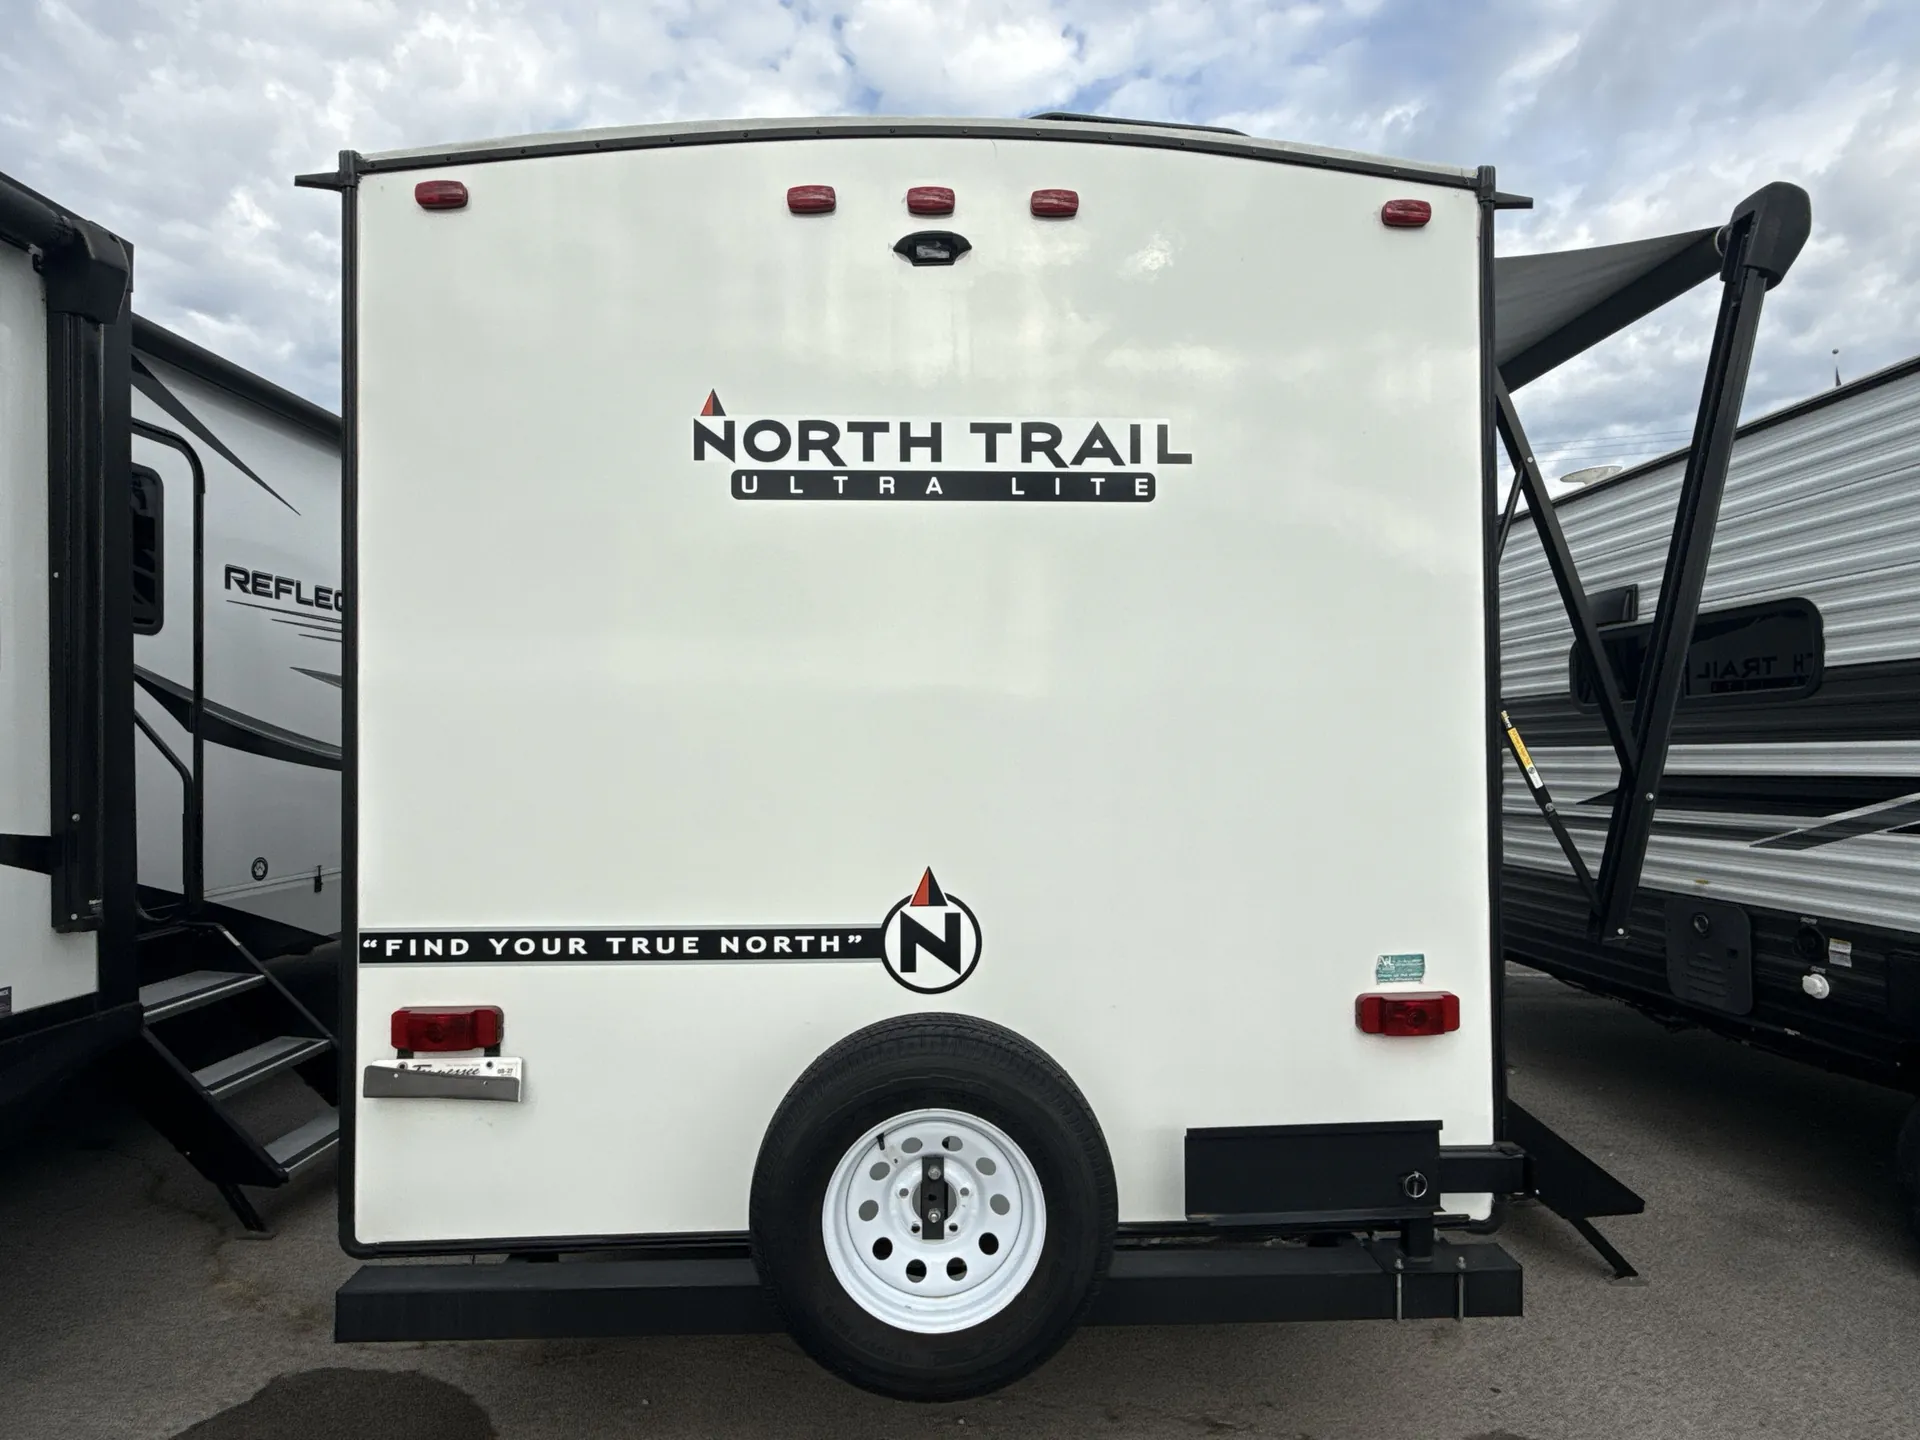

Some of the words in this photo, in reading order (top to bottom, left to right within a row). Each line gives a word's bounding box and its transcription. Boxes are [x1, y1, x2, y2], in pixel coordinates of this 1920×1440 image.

[693, 418, 942, 467] NORTH
[969, 421, 1193, 469] TRAIL
[741, 475, 943, 495] ULTRA
[1012, 476, 1149, 496] LITE
[488, 937, 588, 956] YOUR
[606, 936, 700, 955] TRUE
[900, 909, 961, 976] N
